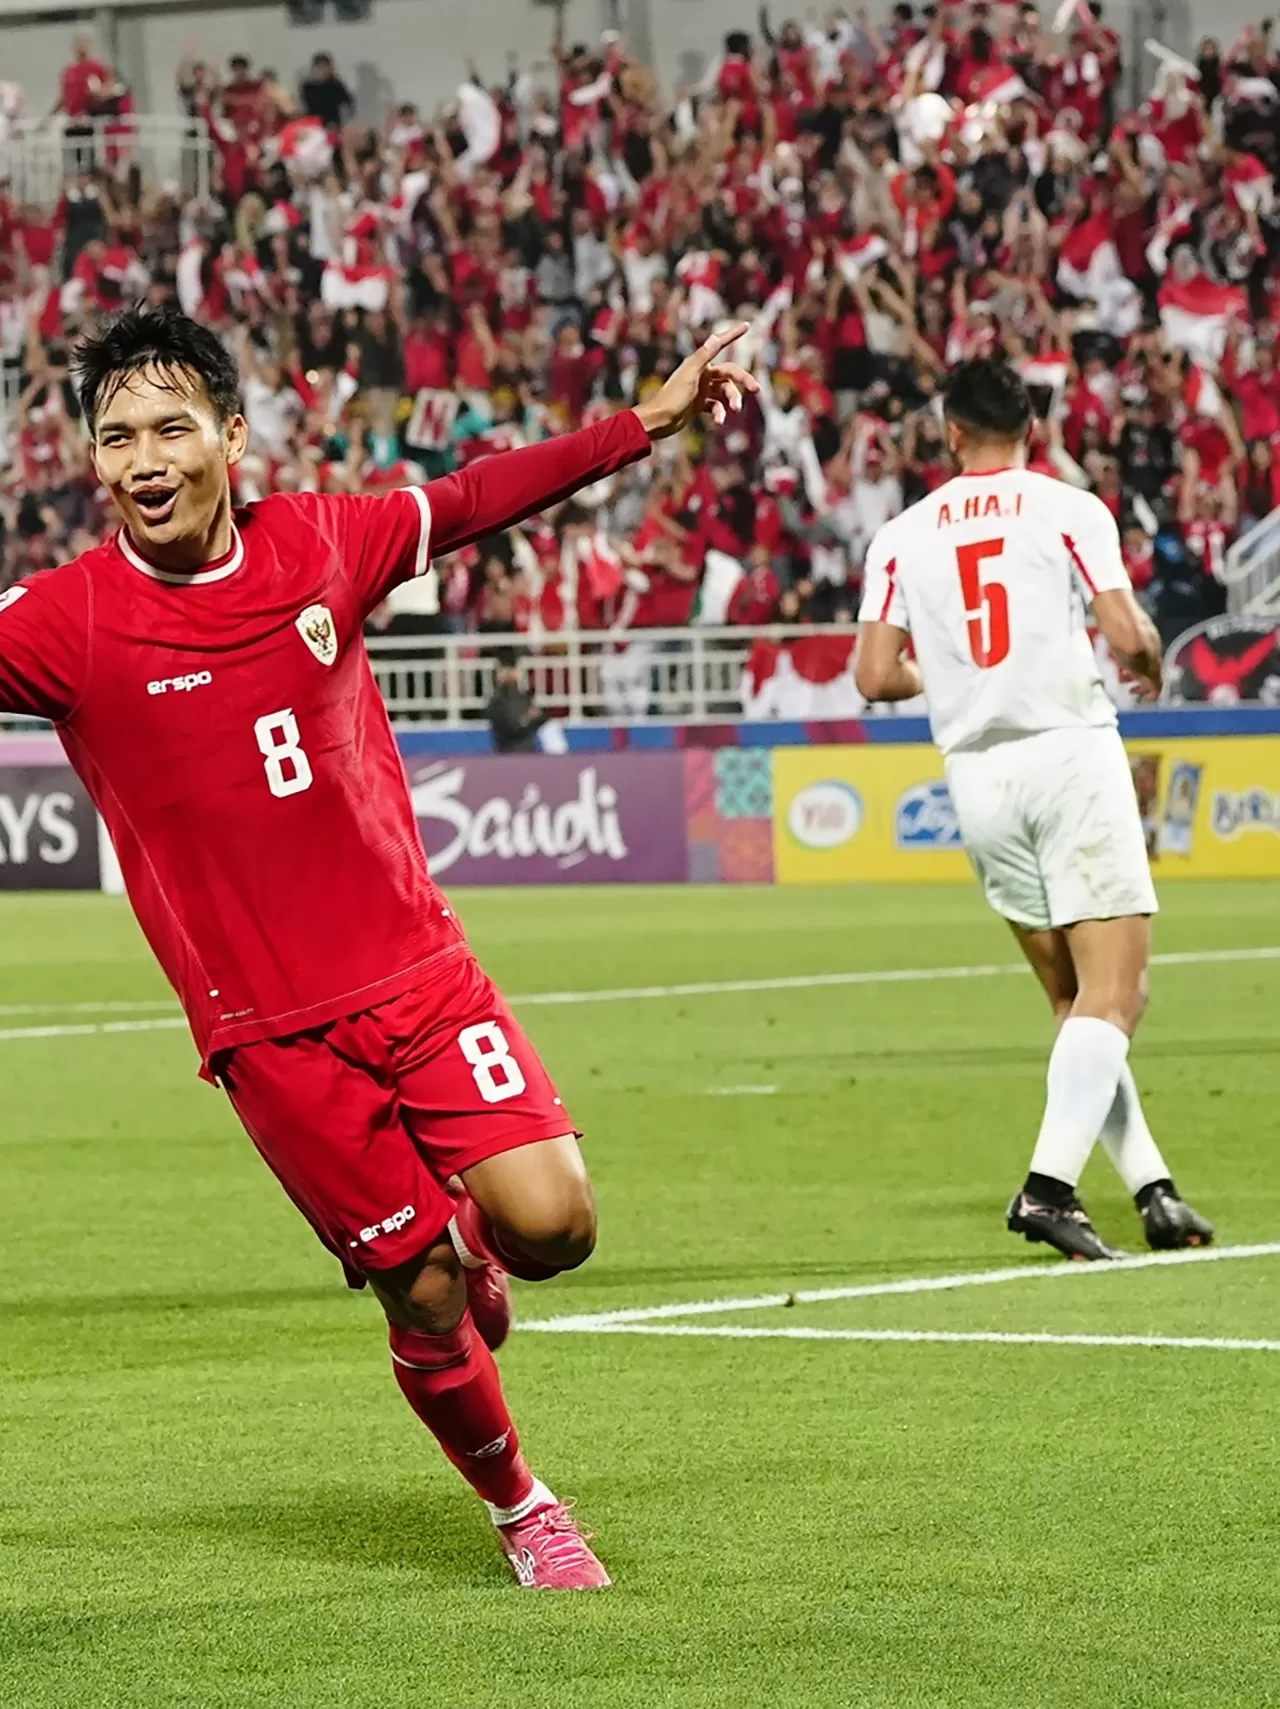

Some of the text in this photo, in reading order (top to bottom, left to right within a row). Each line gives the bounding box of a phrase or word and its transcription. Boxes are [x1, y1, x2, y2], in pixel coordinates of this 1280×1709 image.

[937, 493, 1023, 530] A.HAI
[955, 536, 1011, 669] 5
[146, 670, 213, 696] erspo
[253, 707, 314, 799] 8
[457, 1020, 527, 1104] 8
[358, 1204, 417, 1244] erspo
